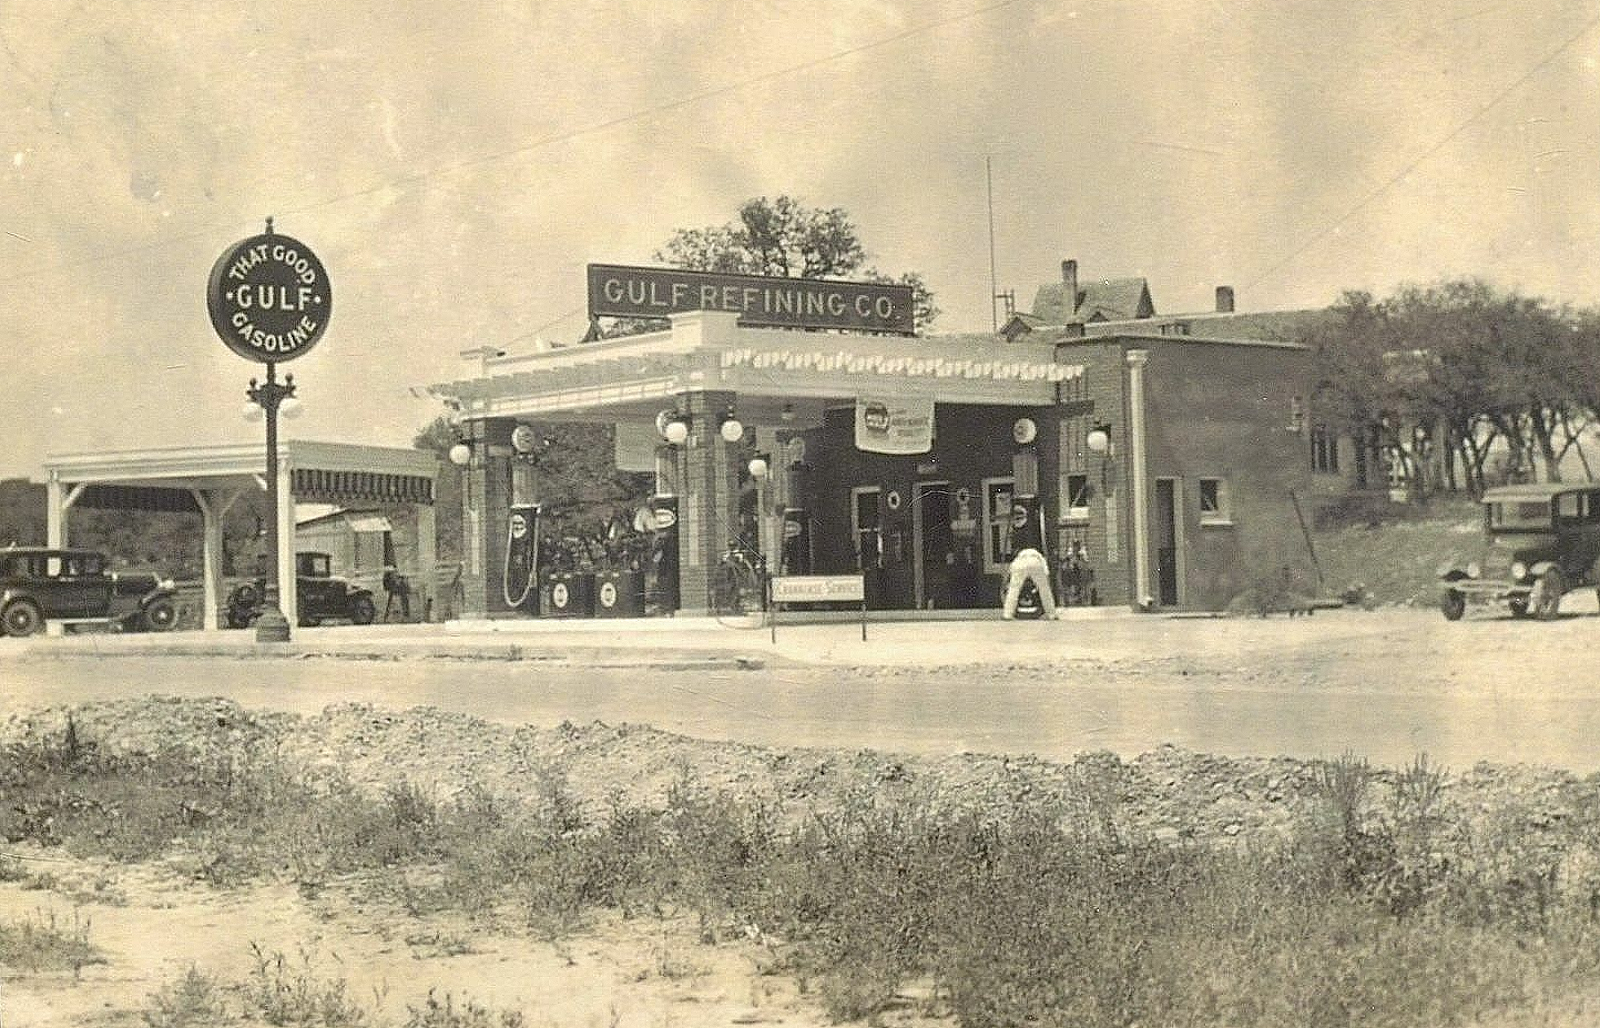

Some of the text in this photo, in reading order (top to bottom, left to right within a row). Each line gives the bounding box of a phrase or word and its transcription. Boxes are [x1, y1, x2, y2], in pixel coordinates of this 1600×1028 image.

[229, 244, 316, 284] THAT GOOD
[237, 284, 312, 311] GULF
[604, 279, 901, 319] GULF REFINING CO.
[232, 312, 317, 352] GASOLINE
